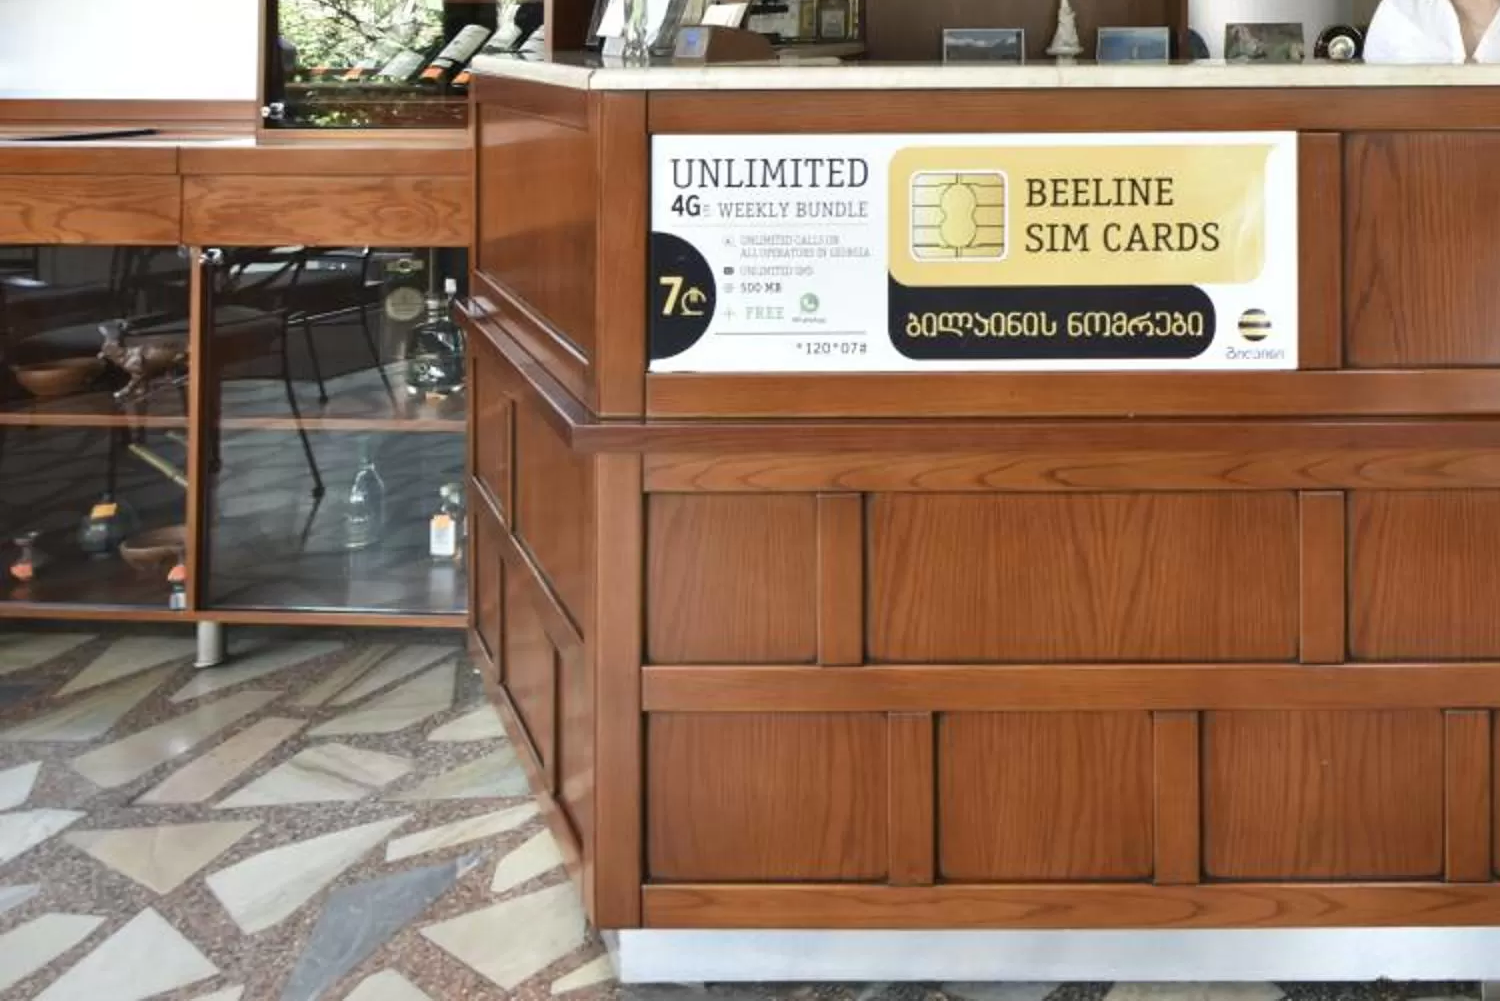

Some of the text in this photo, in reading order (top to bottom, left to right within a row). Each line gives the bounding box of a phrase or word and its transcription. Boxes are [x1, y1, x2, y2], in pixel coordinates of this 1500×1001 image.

[671, 158, 869, 189] UNLIMITED
[1025, 177, 1174, 207] BEELINE
[717, 202, 790, 218] WEEKLY
[796, 201, 869, 218] BUNDLE
[1025, 222, 1220, 252] SIM CARDS
[745, 306, 784, 320] FREE
